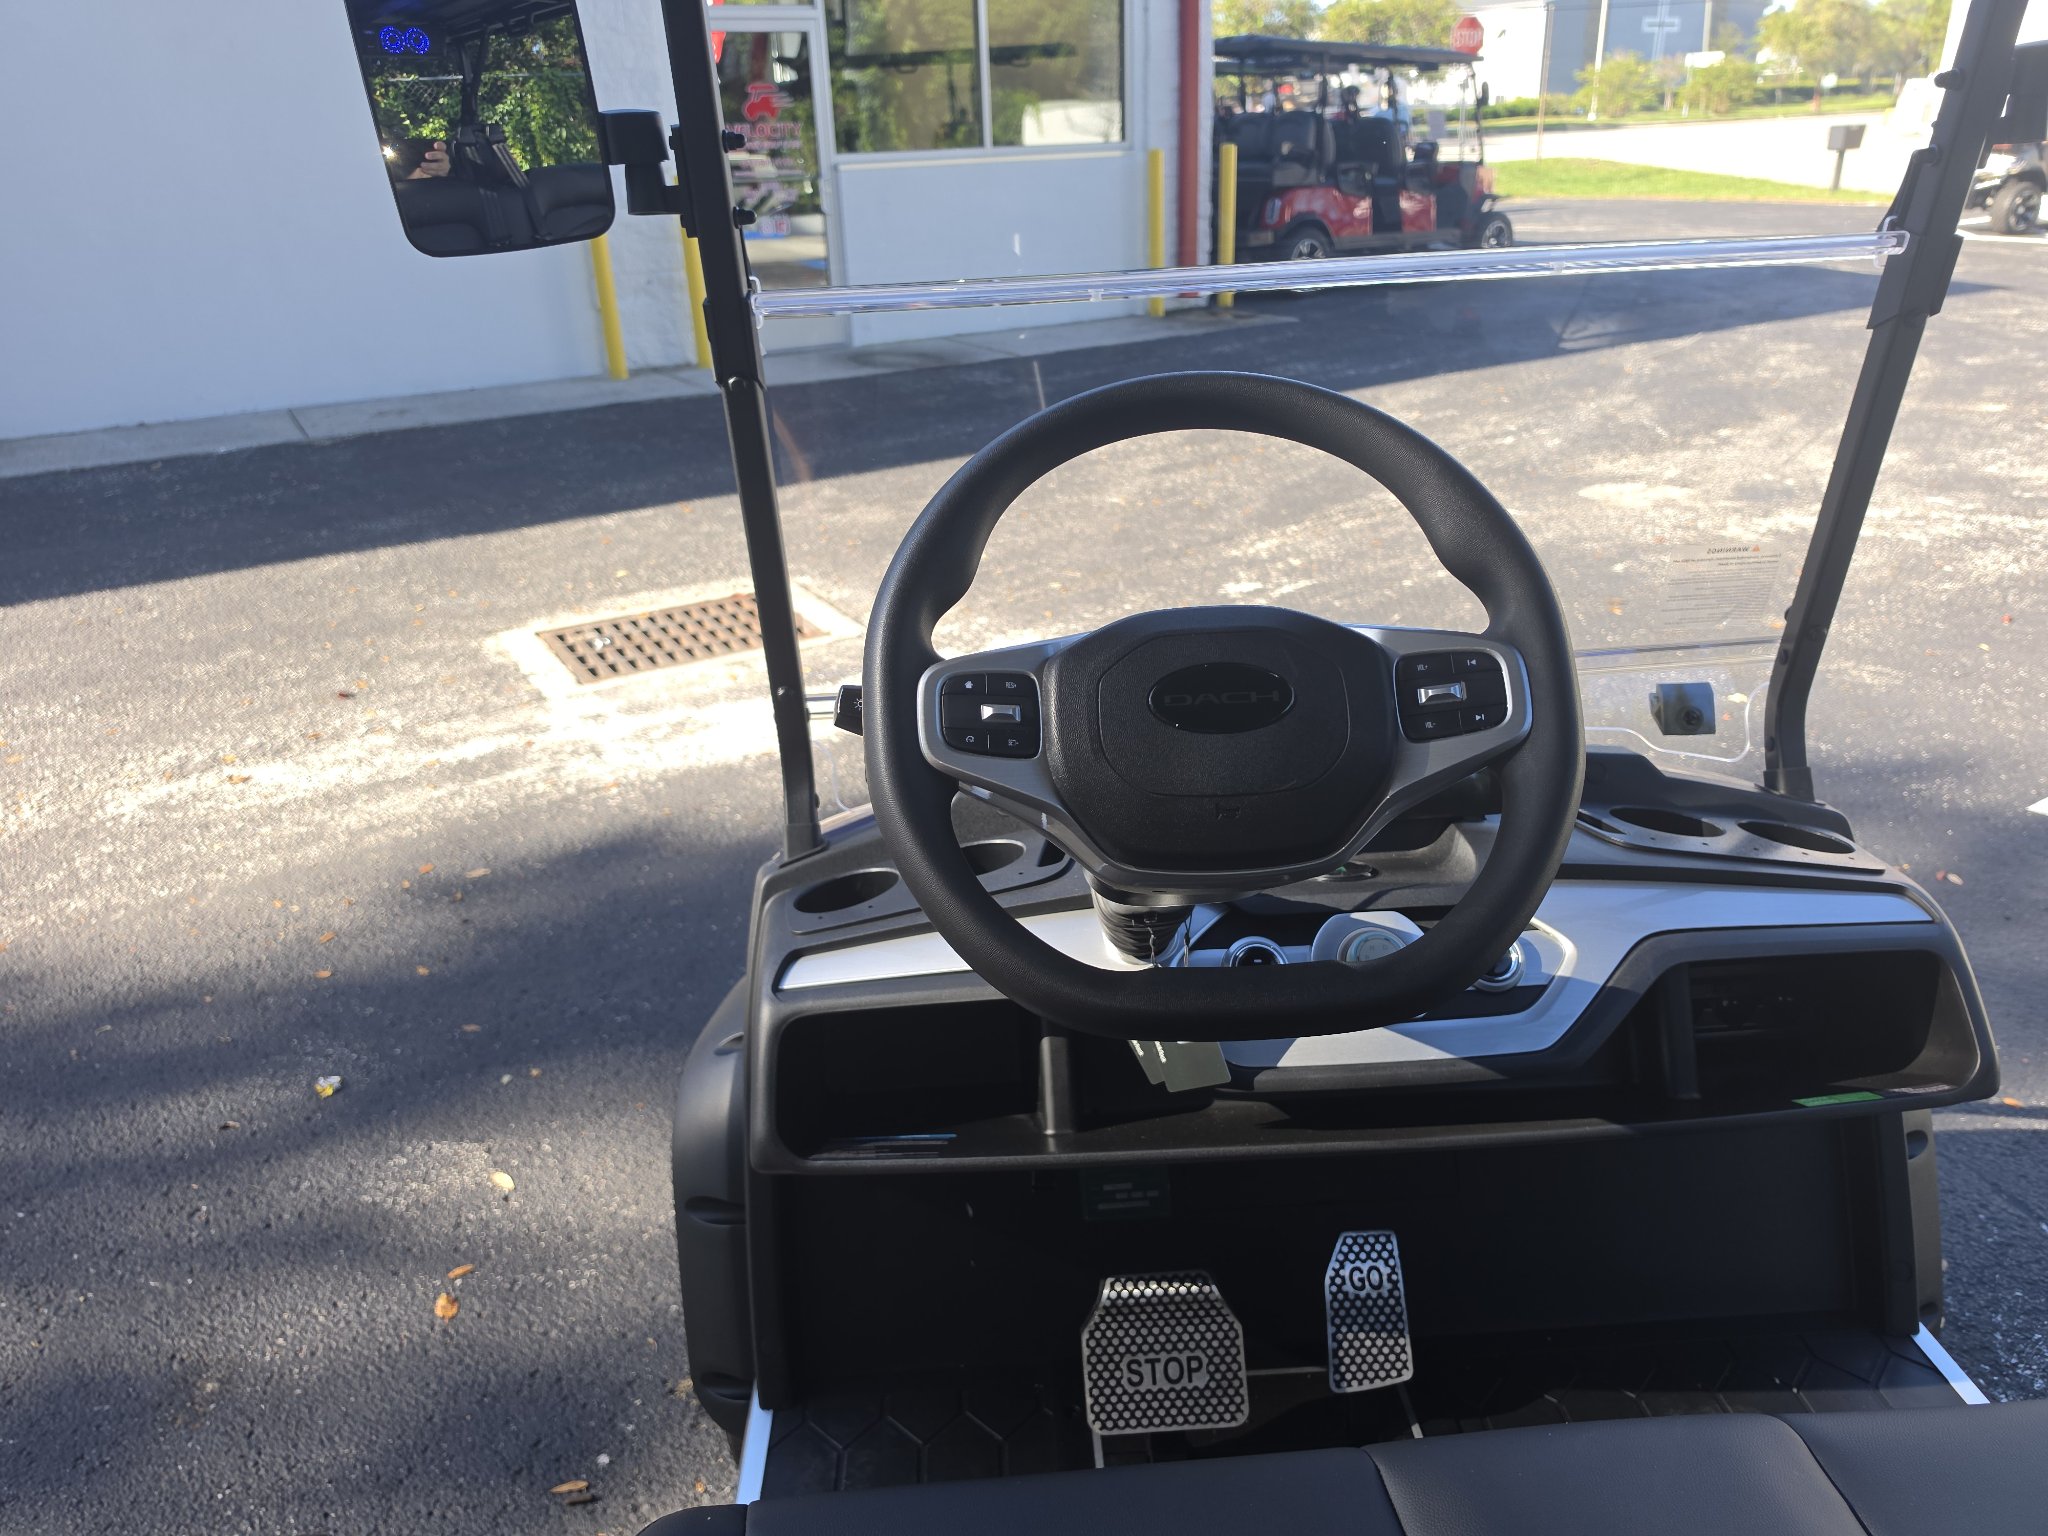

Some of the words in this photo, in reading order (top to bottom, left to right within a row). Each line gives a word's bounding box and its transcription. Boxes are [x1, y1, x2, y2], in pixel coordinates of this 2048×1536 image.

[1164, 690, 1280, 707] DACH
[1348, 1265, 1384, 1292] GO
[1126, 1354, 1204, 1387] STOP
